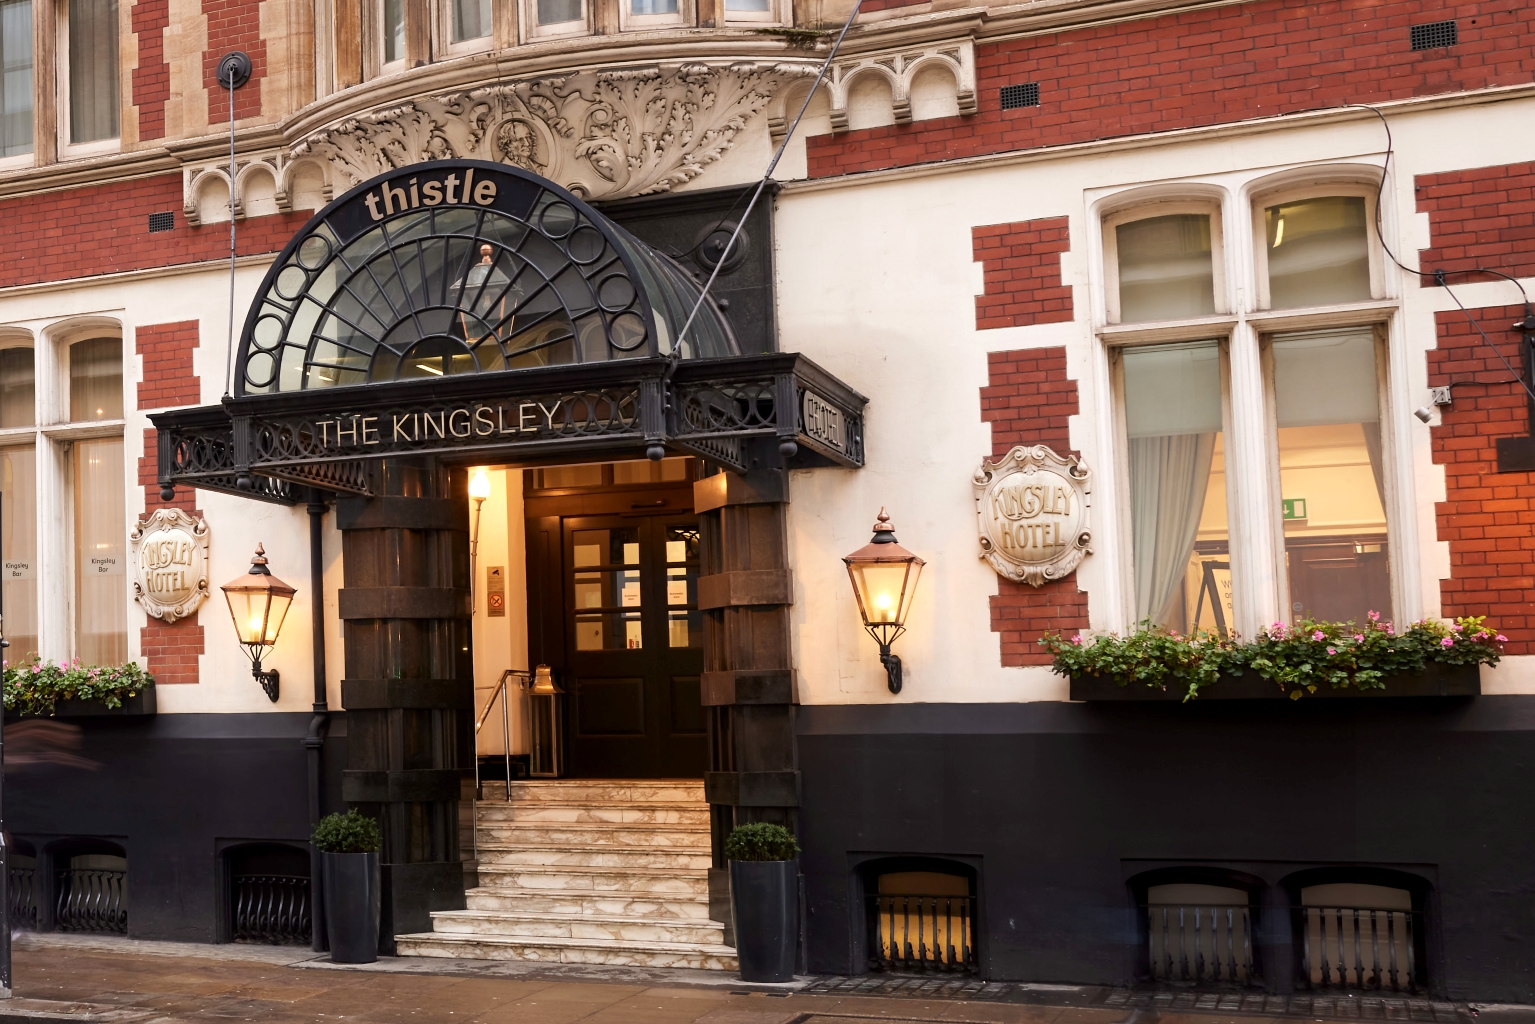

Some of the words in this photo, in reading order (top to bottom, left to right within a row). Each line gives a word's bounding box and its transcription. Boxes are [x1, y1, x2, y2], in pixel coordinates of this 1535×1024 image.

[365, 168, 497, 221] thistle
[316, 417, 379, 448] THE
[393, 401, 562, 442] KINGSLEY
[990, 484, 1075, 521] KINGSLEY
[1000, 522, 1066, 548] HOTEL
[5, 562, 28, 570] Kingsley
[141, 540, 197, 570] KINGSLEY
[145, 571, 190, 592] HOTEL
